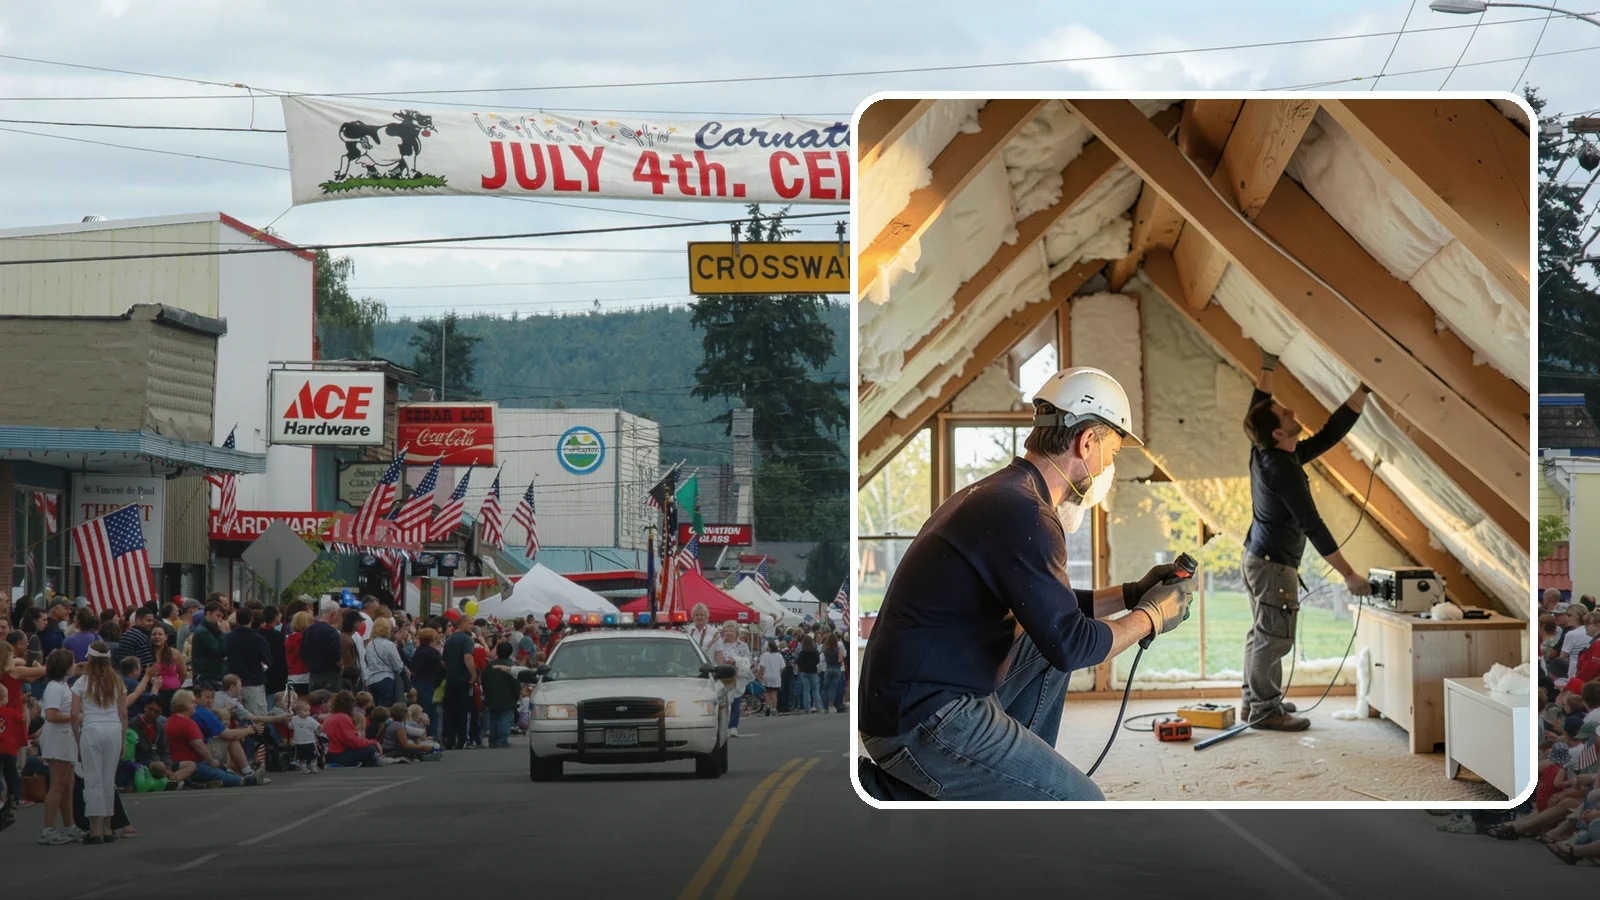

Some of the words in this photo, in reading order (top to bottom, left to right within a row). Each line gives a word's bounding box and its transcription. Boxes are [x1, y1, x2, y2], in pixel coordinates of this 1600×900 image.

[695, 121, 850, 150] Carnat
[481, 140, 604, 192] JULY
[633, 150, 746, 198] 4th.
[697, 254, 850, 280] CROSSWA
[283, 380, 373, 420] ACE
[406, 409, 452, 422] CEDAR
[284, 421, 370, 437] Hardware
[96, 485, 124, 495] Vincent
[126, 486, 136, 495] de
[137, 486, 155, 495] Paul
[688, 526, 741, 535] CRNATION
[699, 535, 730, 543] GLASS
